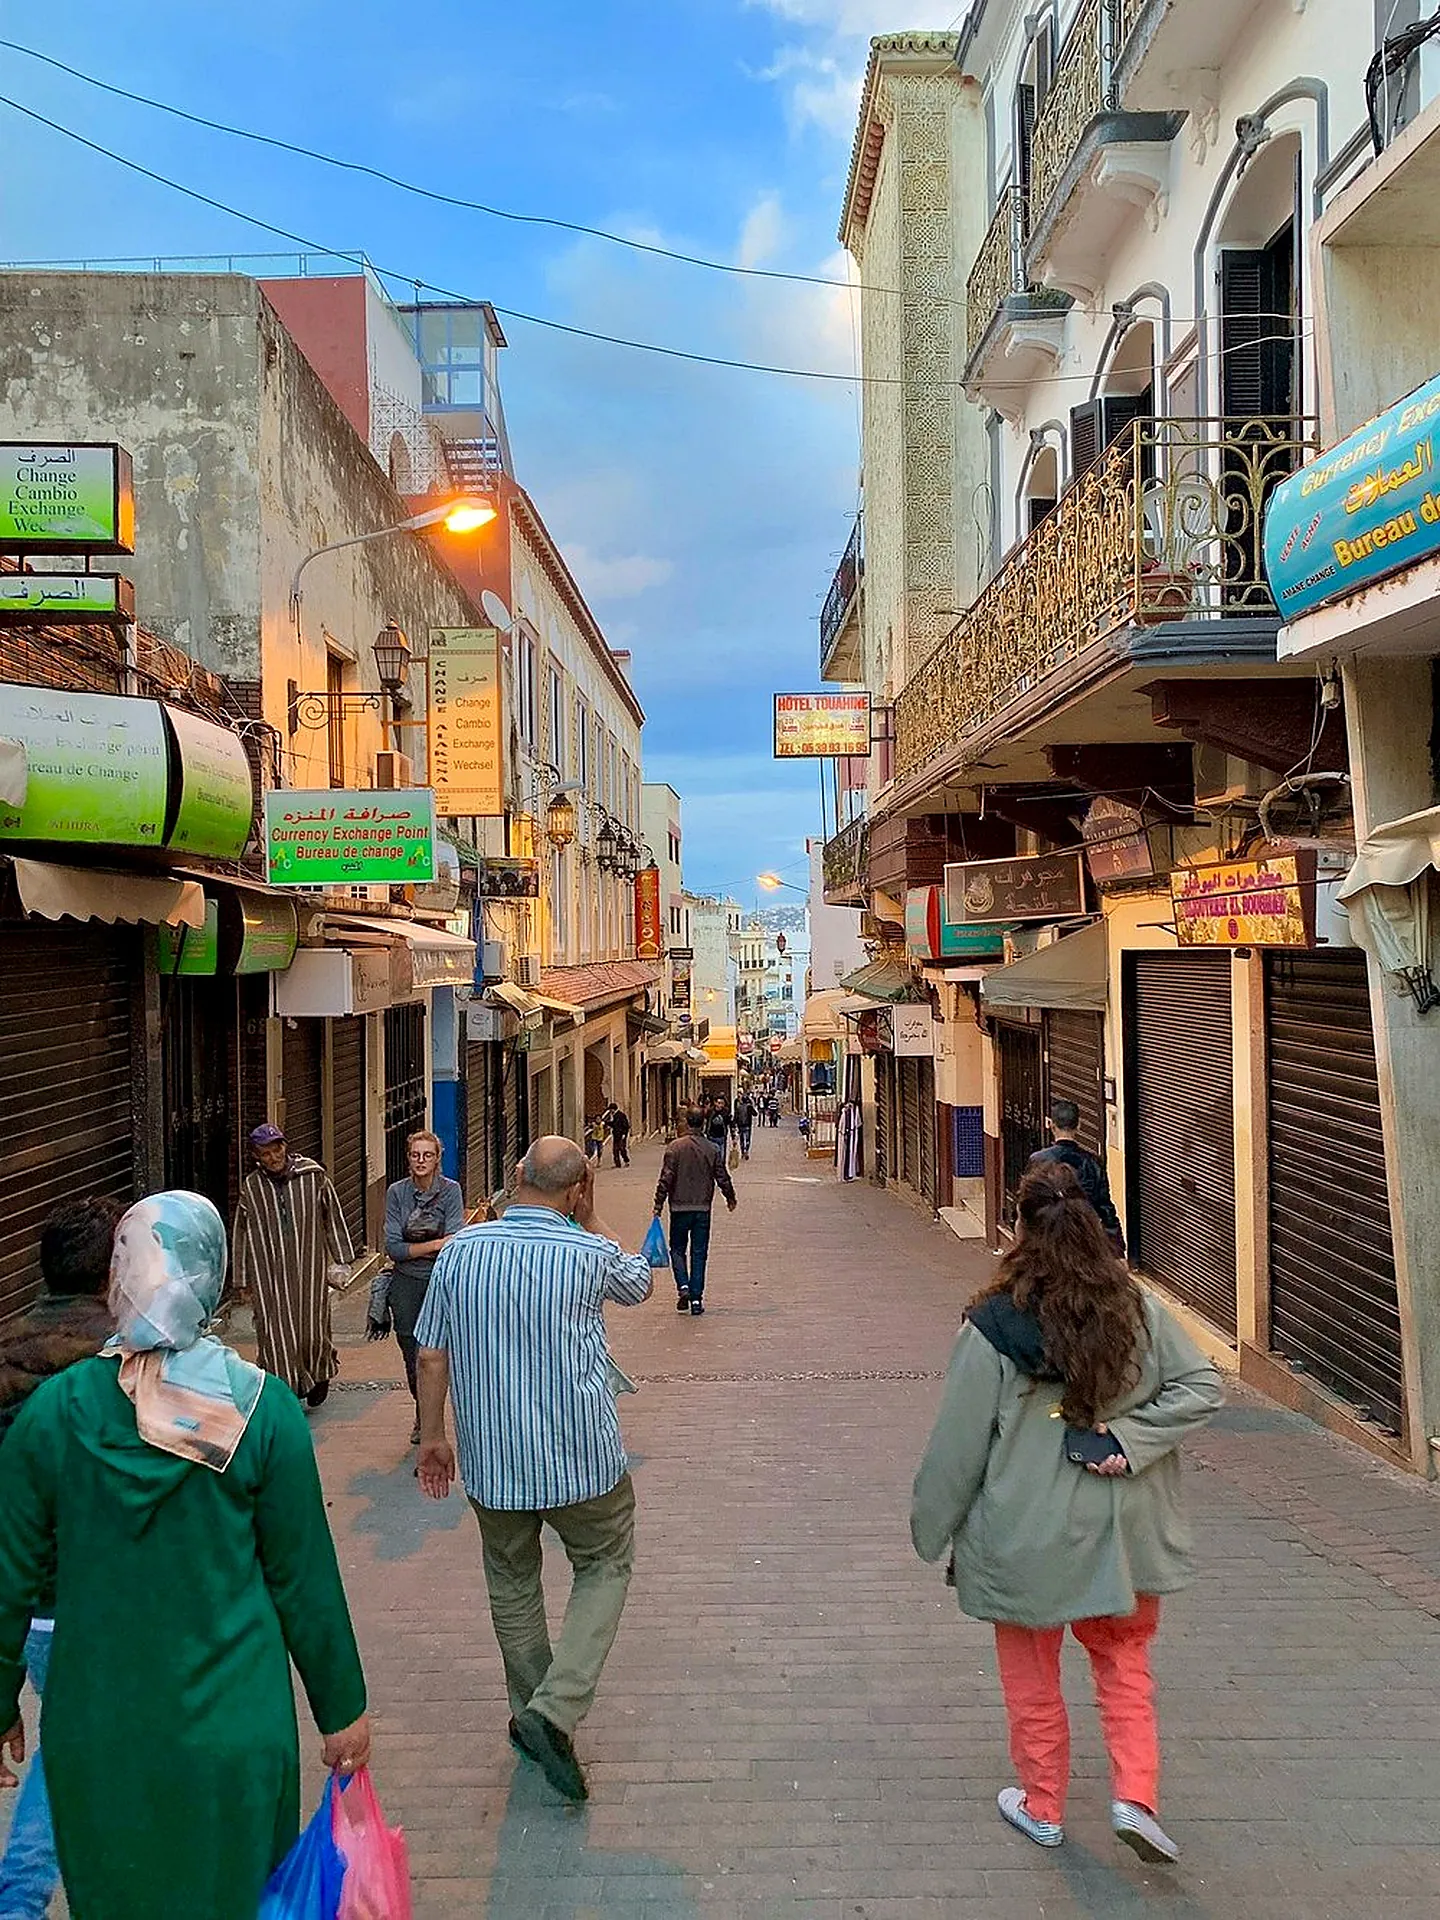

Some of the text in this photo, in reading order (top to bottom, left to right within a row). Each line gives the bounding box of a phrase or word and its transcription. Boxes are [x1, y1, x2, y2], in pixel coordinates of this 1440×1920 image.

[18, 449, 76, 468] الصرف
[1302, 427, 1390, 496] Currency
[16, 467, 77, 488] Change
[15, 485, 78, 501] Cambio
[8, 500, 85, 519] Exchange
[1332, 510, 1417, 568] Bureau
[1305, 565, 1337, 587] CHANGE
[1, 580, 85, 606] الصرف
[457, 672, 488, 685] صرف
[455, 697, 491, 710] Change
[455, 718, 491, 729] Cambio
[453, 738, 495, 751] Exchange
[27, 762, 140, 782] ureau de Change
[453, 759, 494, 770] Wechsel
[283, 807, 411, 824] صرافة المنزه
[271, 826, 429, 843] Currency Exchange Point
[296, 846, 404, 861] Bureau de change
